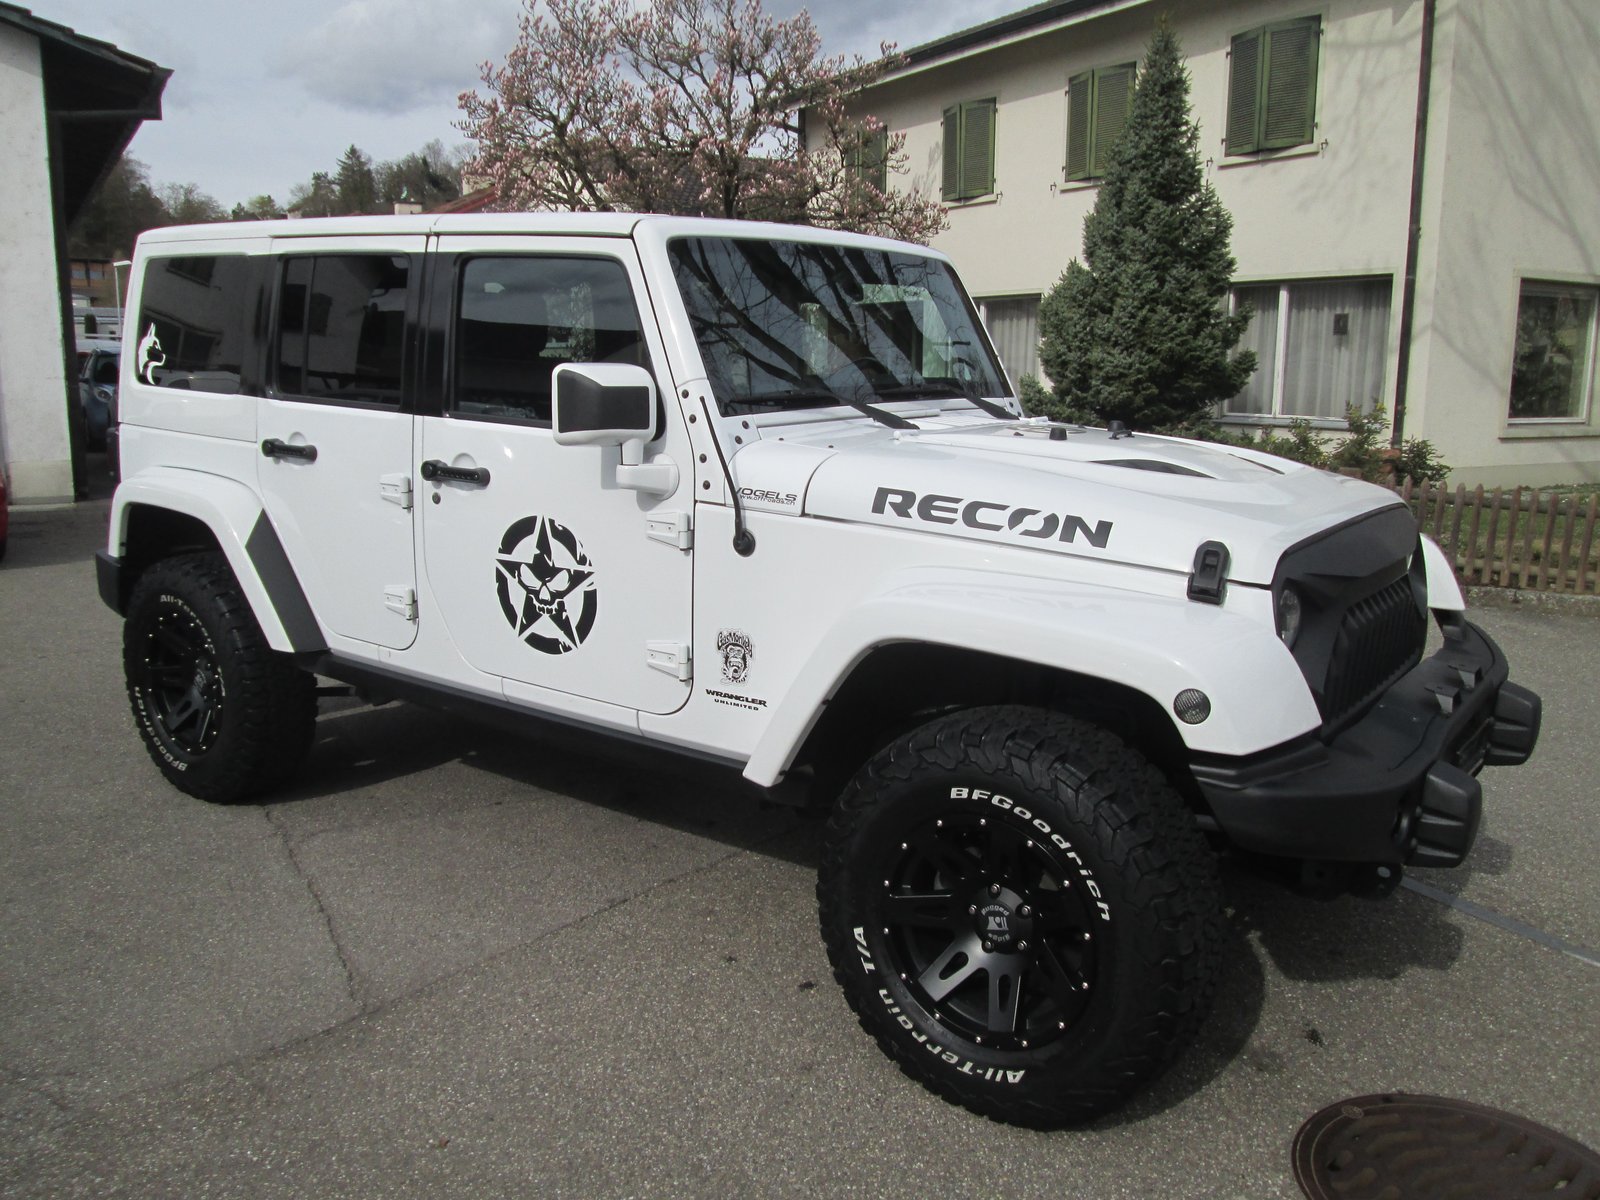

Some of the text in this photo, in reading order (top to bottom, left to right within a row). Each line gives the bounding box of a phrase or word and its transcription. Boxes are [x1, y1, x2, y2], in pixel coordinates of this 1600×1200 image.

[871, 486, 1113, 549] RECON
[705, 688, 768, 707] WRANGLER
[714, 698, 759, 711] UNLIMITED
[950, 787, 1111, 921] BFGoodrich
[853, 926, 1026, 1085] All-Terrain T/A
